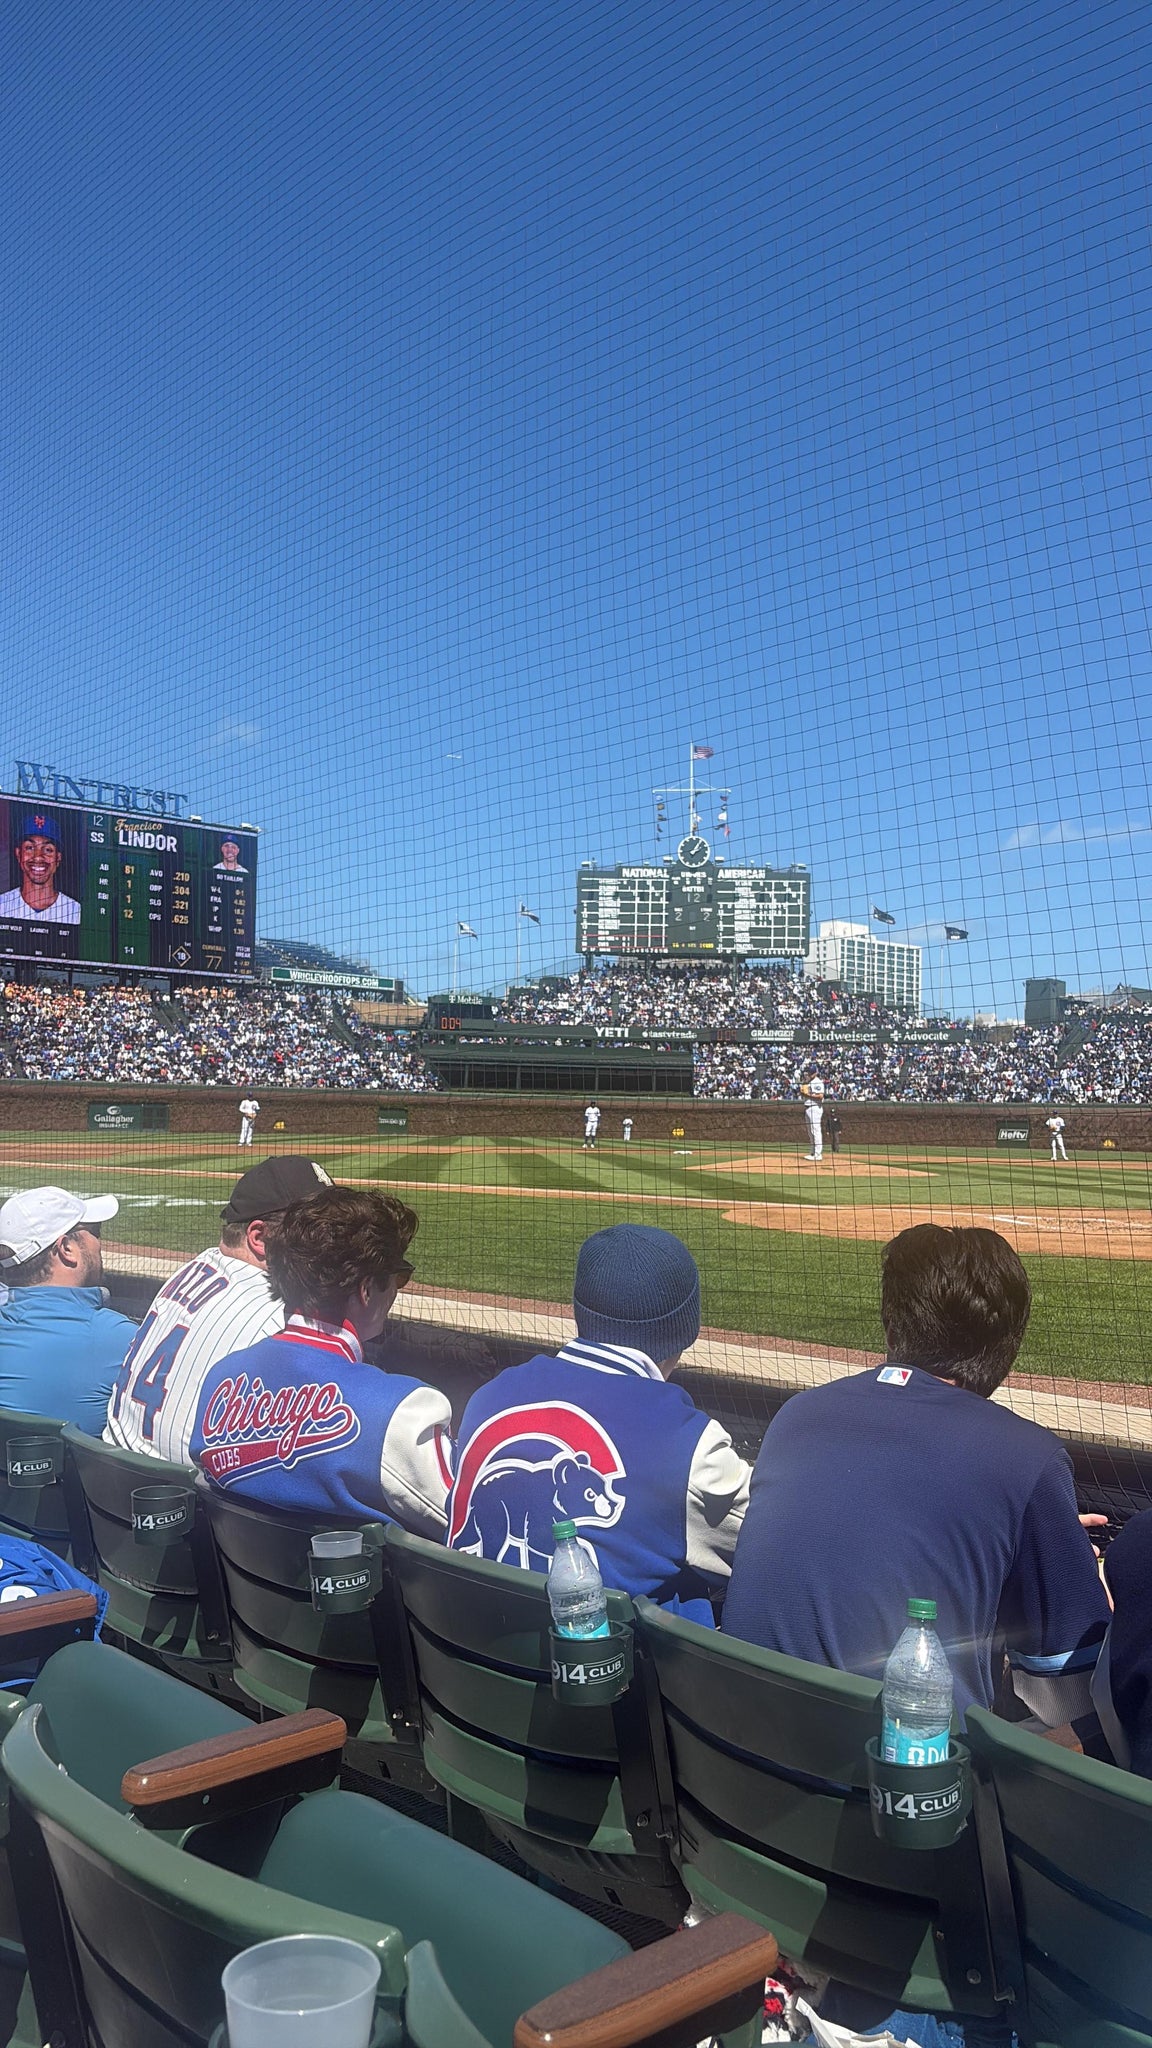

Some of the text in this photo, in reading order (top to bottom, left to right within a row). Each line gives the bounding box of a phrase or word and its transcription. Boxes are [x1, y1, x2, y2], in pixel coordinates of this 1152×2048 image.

[15, 760, 188, 817] WINTRUST
[93, 815, 103, 826] 12
[115, 818, 162, 832] Francisco
[90, 831, 104, 843] SS
[119, 829, 177, 852] LINDOR
[99, 863, 135, 874] AB 81
[622, 868, 766, 879] NATIONAL AMERICAN
[150, 869, 190, 882] AVG .210
[99, 878, 132, 888] HR 1
[172, 886, 190, 896] .304
[126, 895, 131, 903] 1
[687, 893, 701, 903] 12
[149, 898, 189, 911] SLG .321
[100, 907, 133, 919] R 12
[149, 913, 189, 925] OPS .625
[675, 911, 711, 921] 2 2
[124, 946, 135, 955] 1-1
[205, 955, 223, 970] 77
[289, 969, 379, 988] WRIGLEYROOFTOPS.COM
[457, 995, 483, 1005] Mobile
[594, 1026, 629, 1038] YETI
[649, 1029, 697, 1040] tastytrade
[751, 1029, 795, 1038] GRAINGER
[809, 1030, 877, 1042] Budweiser
[903, 1030, 950, 1041] Advocate
[93, 1113, 135, 1123] Gallagher
[201, 1372, 353, 1460] Chicago
[211, 1447, 241, 1473] CUBS
[23, 1461, 50, 1473] CLUB
[156, 1511, 184, 1525] CLUB
[335, 1575, 367, 1589] CLUB
[588, 1660, 622, 1678] CLUB
[920, 1790, 959, 1812] CLUB
